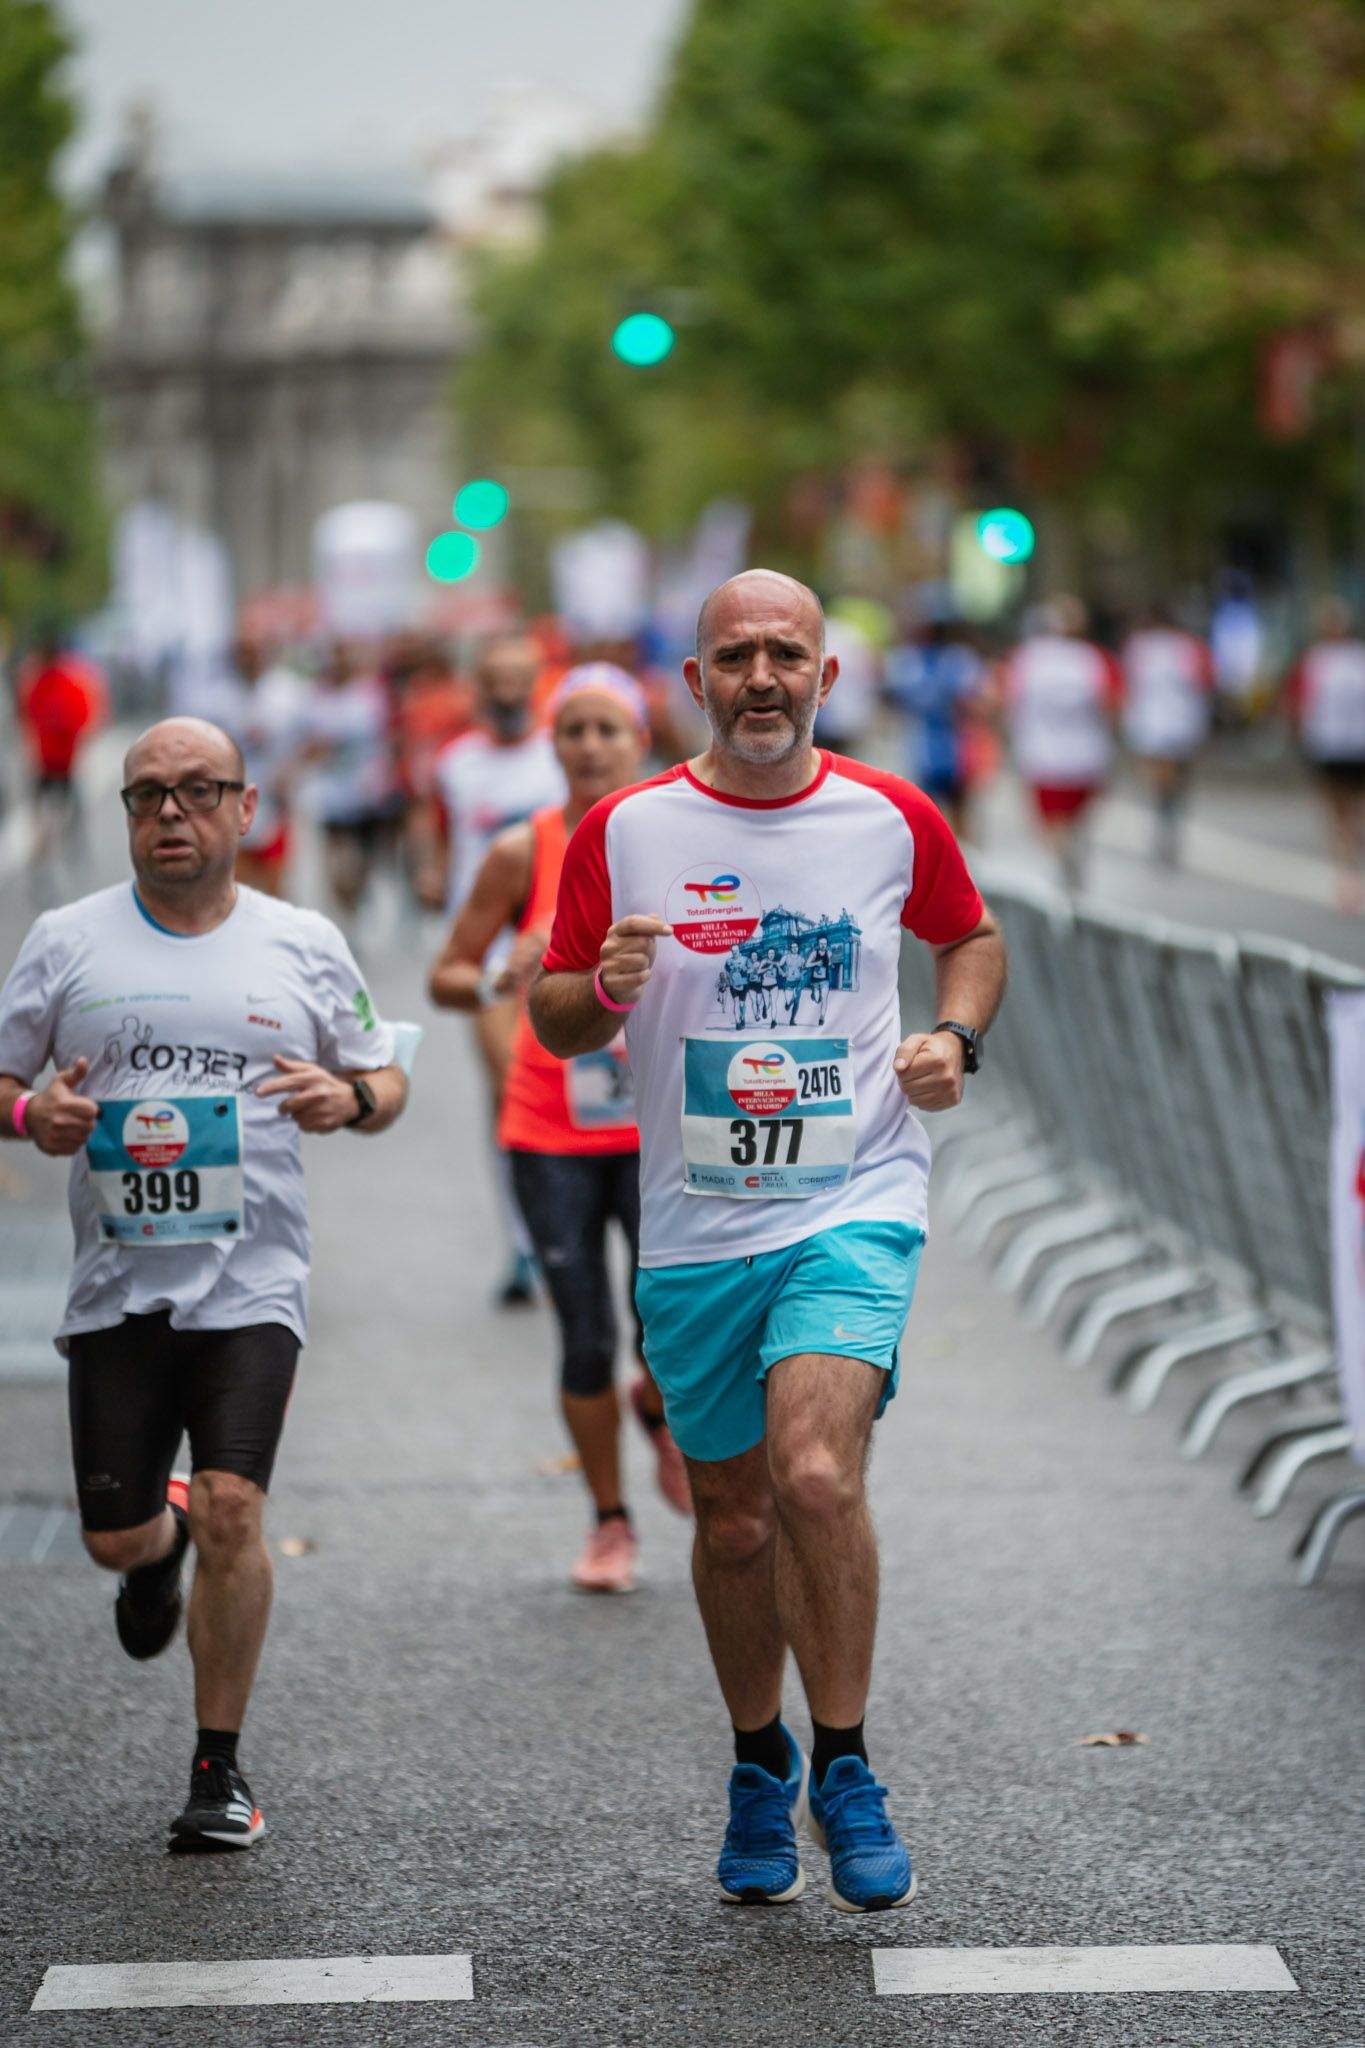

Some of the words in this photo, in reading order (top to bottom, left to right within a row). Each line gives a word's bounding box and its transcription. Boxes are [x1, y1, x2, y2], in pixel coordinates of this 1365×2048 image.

[686, 906, 743, 916] TotalEnergies
[701, 922, 728, 931] MILLA
[692, 940, 704, 948] DE
[130, 1044, 248, 1080] CORRER
[798, 1064, 842, 1099] 2476
[730, 1119, 804, 1167] 377
[121, 1169, 201, 1215] 399
[702, 1175, 735, 1186] MADRID
